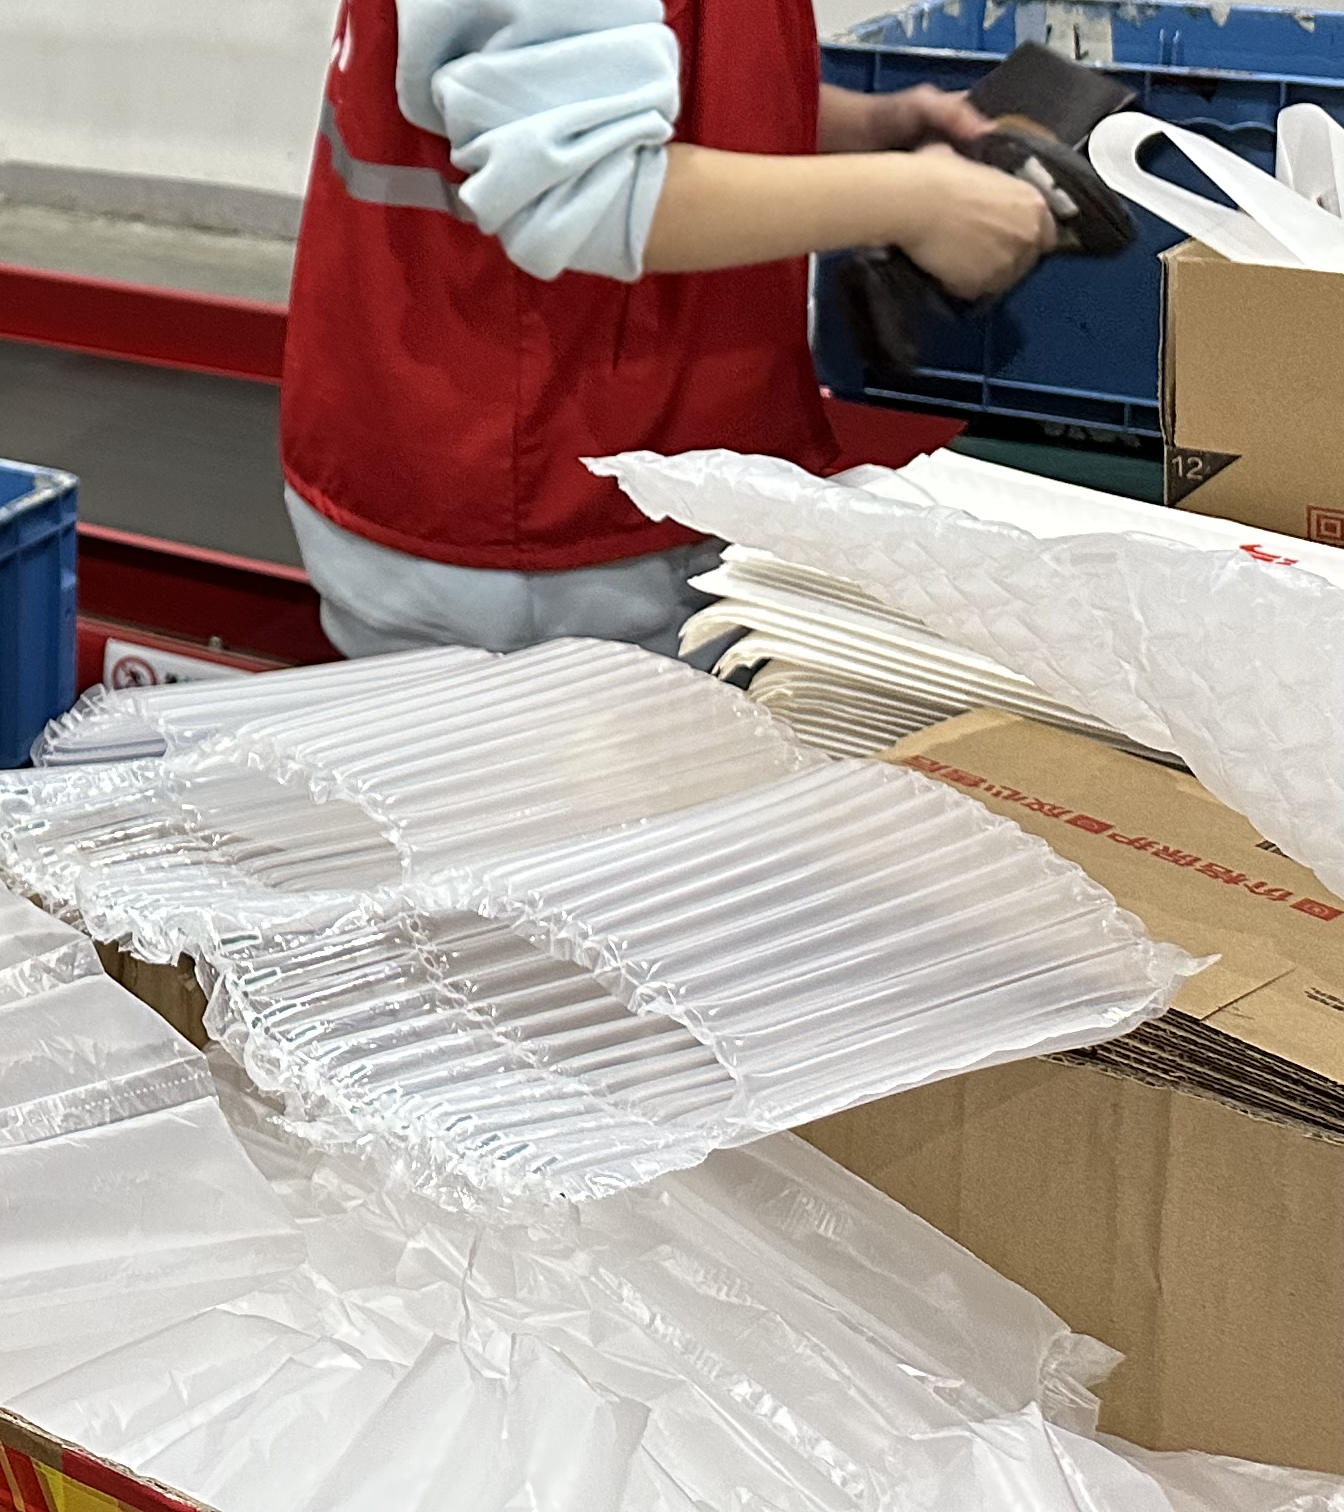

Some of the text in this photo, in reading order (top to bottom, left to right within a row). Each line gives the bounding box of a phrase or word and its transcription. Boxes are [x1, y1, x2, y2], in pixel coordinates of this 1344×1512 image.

[1172, 456, 1203, 480] 12
[901, 755, 1293, 903] 价格保护 放心售后
